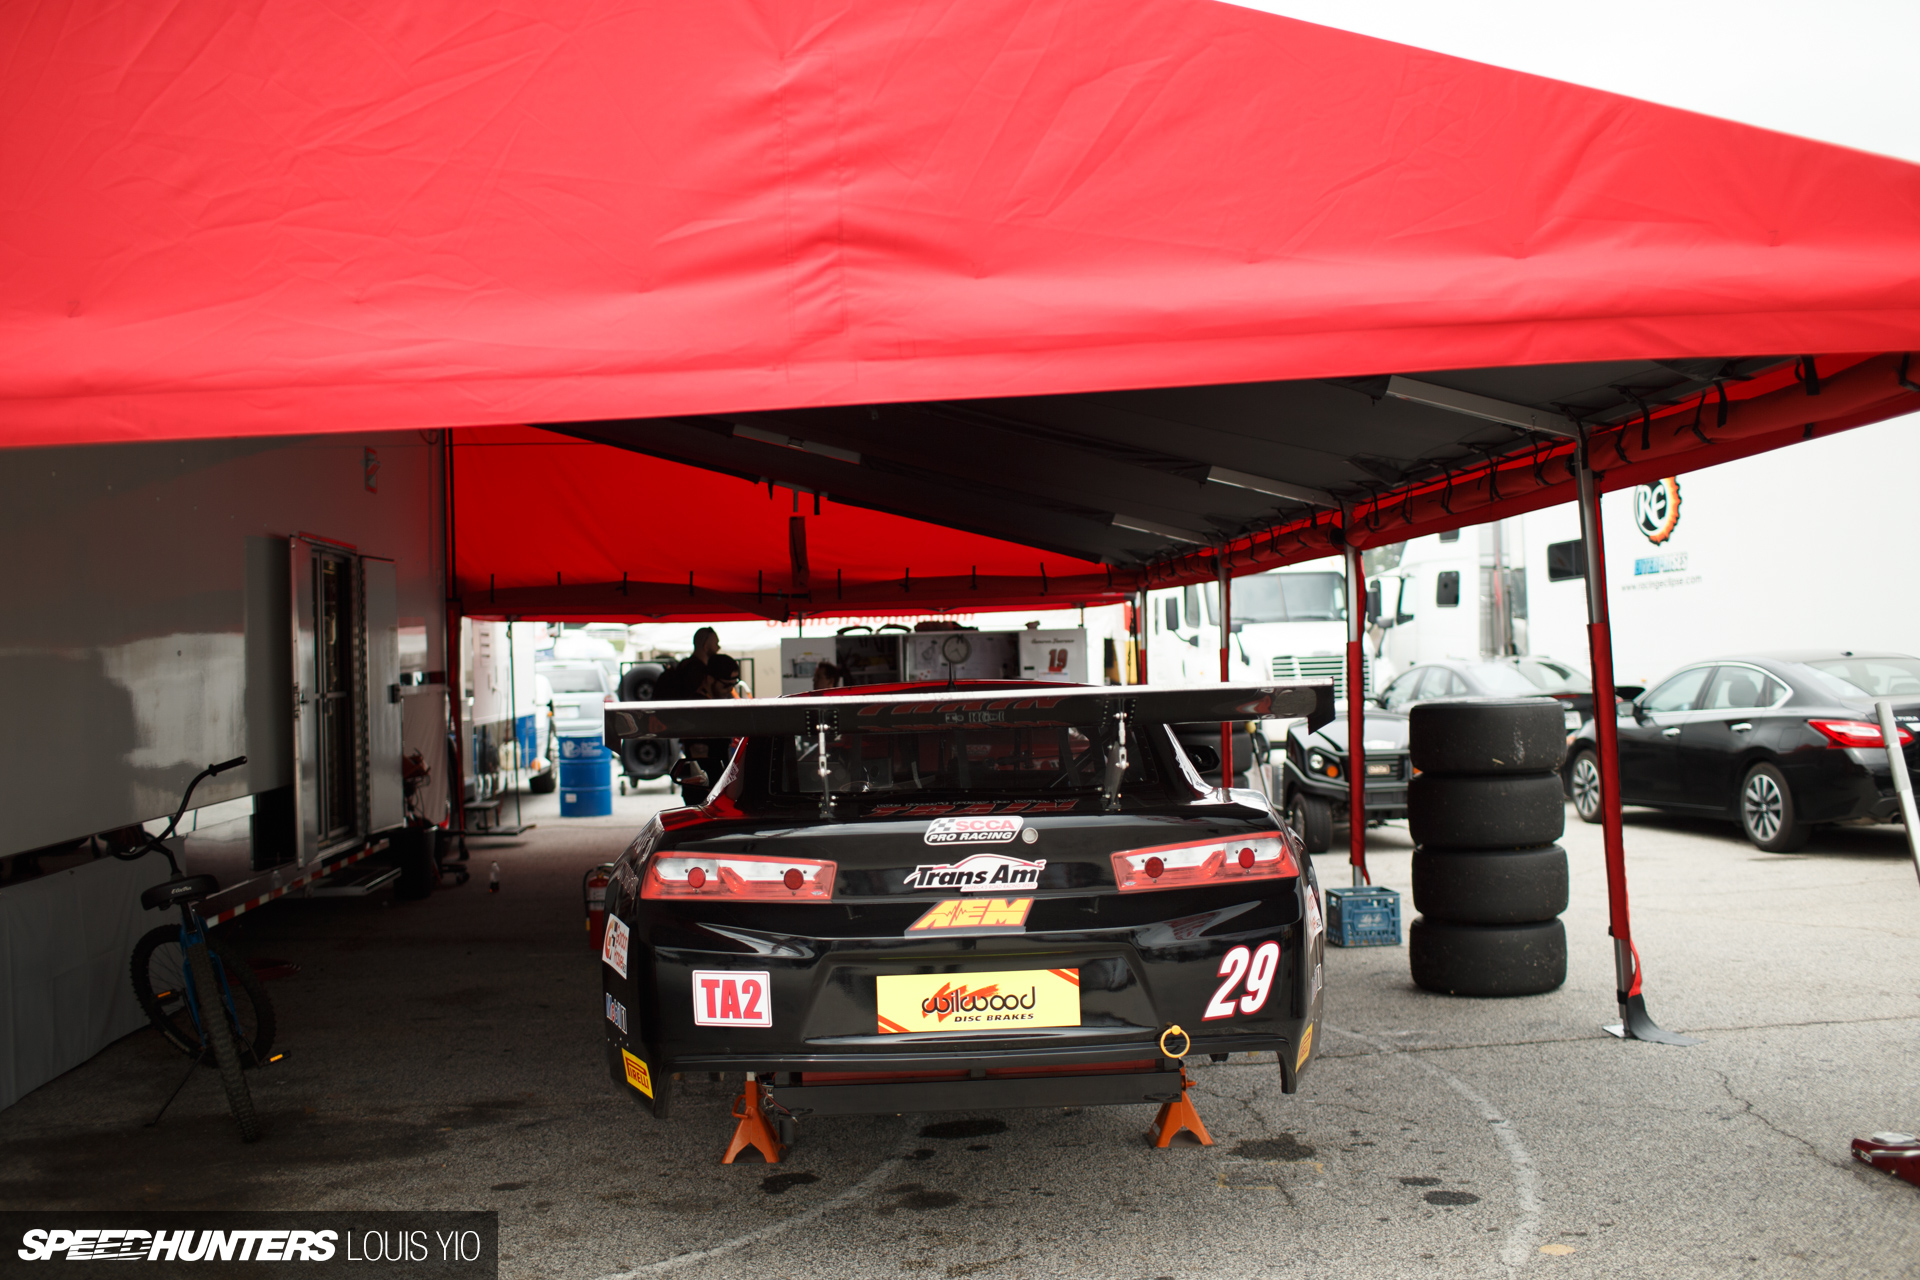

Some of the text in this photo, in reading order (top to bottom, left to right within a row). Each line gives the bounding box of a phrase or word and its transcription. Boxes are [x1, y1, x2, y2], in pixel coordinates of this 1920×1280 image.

[1048, 648, 1068, 669] 19
[928, 831, 1013, 842] PRO RACING
[955, 820, 1015, 831] SCCA
[916, 864, 1037, 886] Trans Am
[911, 898, 1033, 930] AEM
[1201, 940, 1281, 1022] 29
[701, 979, 763, 1019] TA2
[921, 986, 1036, 1014] wilwood
[954, 1013, 1035, 1023] DISC BRAKES
[625, 1056, 650, 1090] PIRELLI
